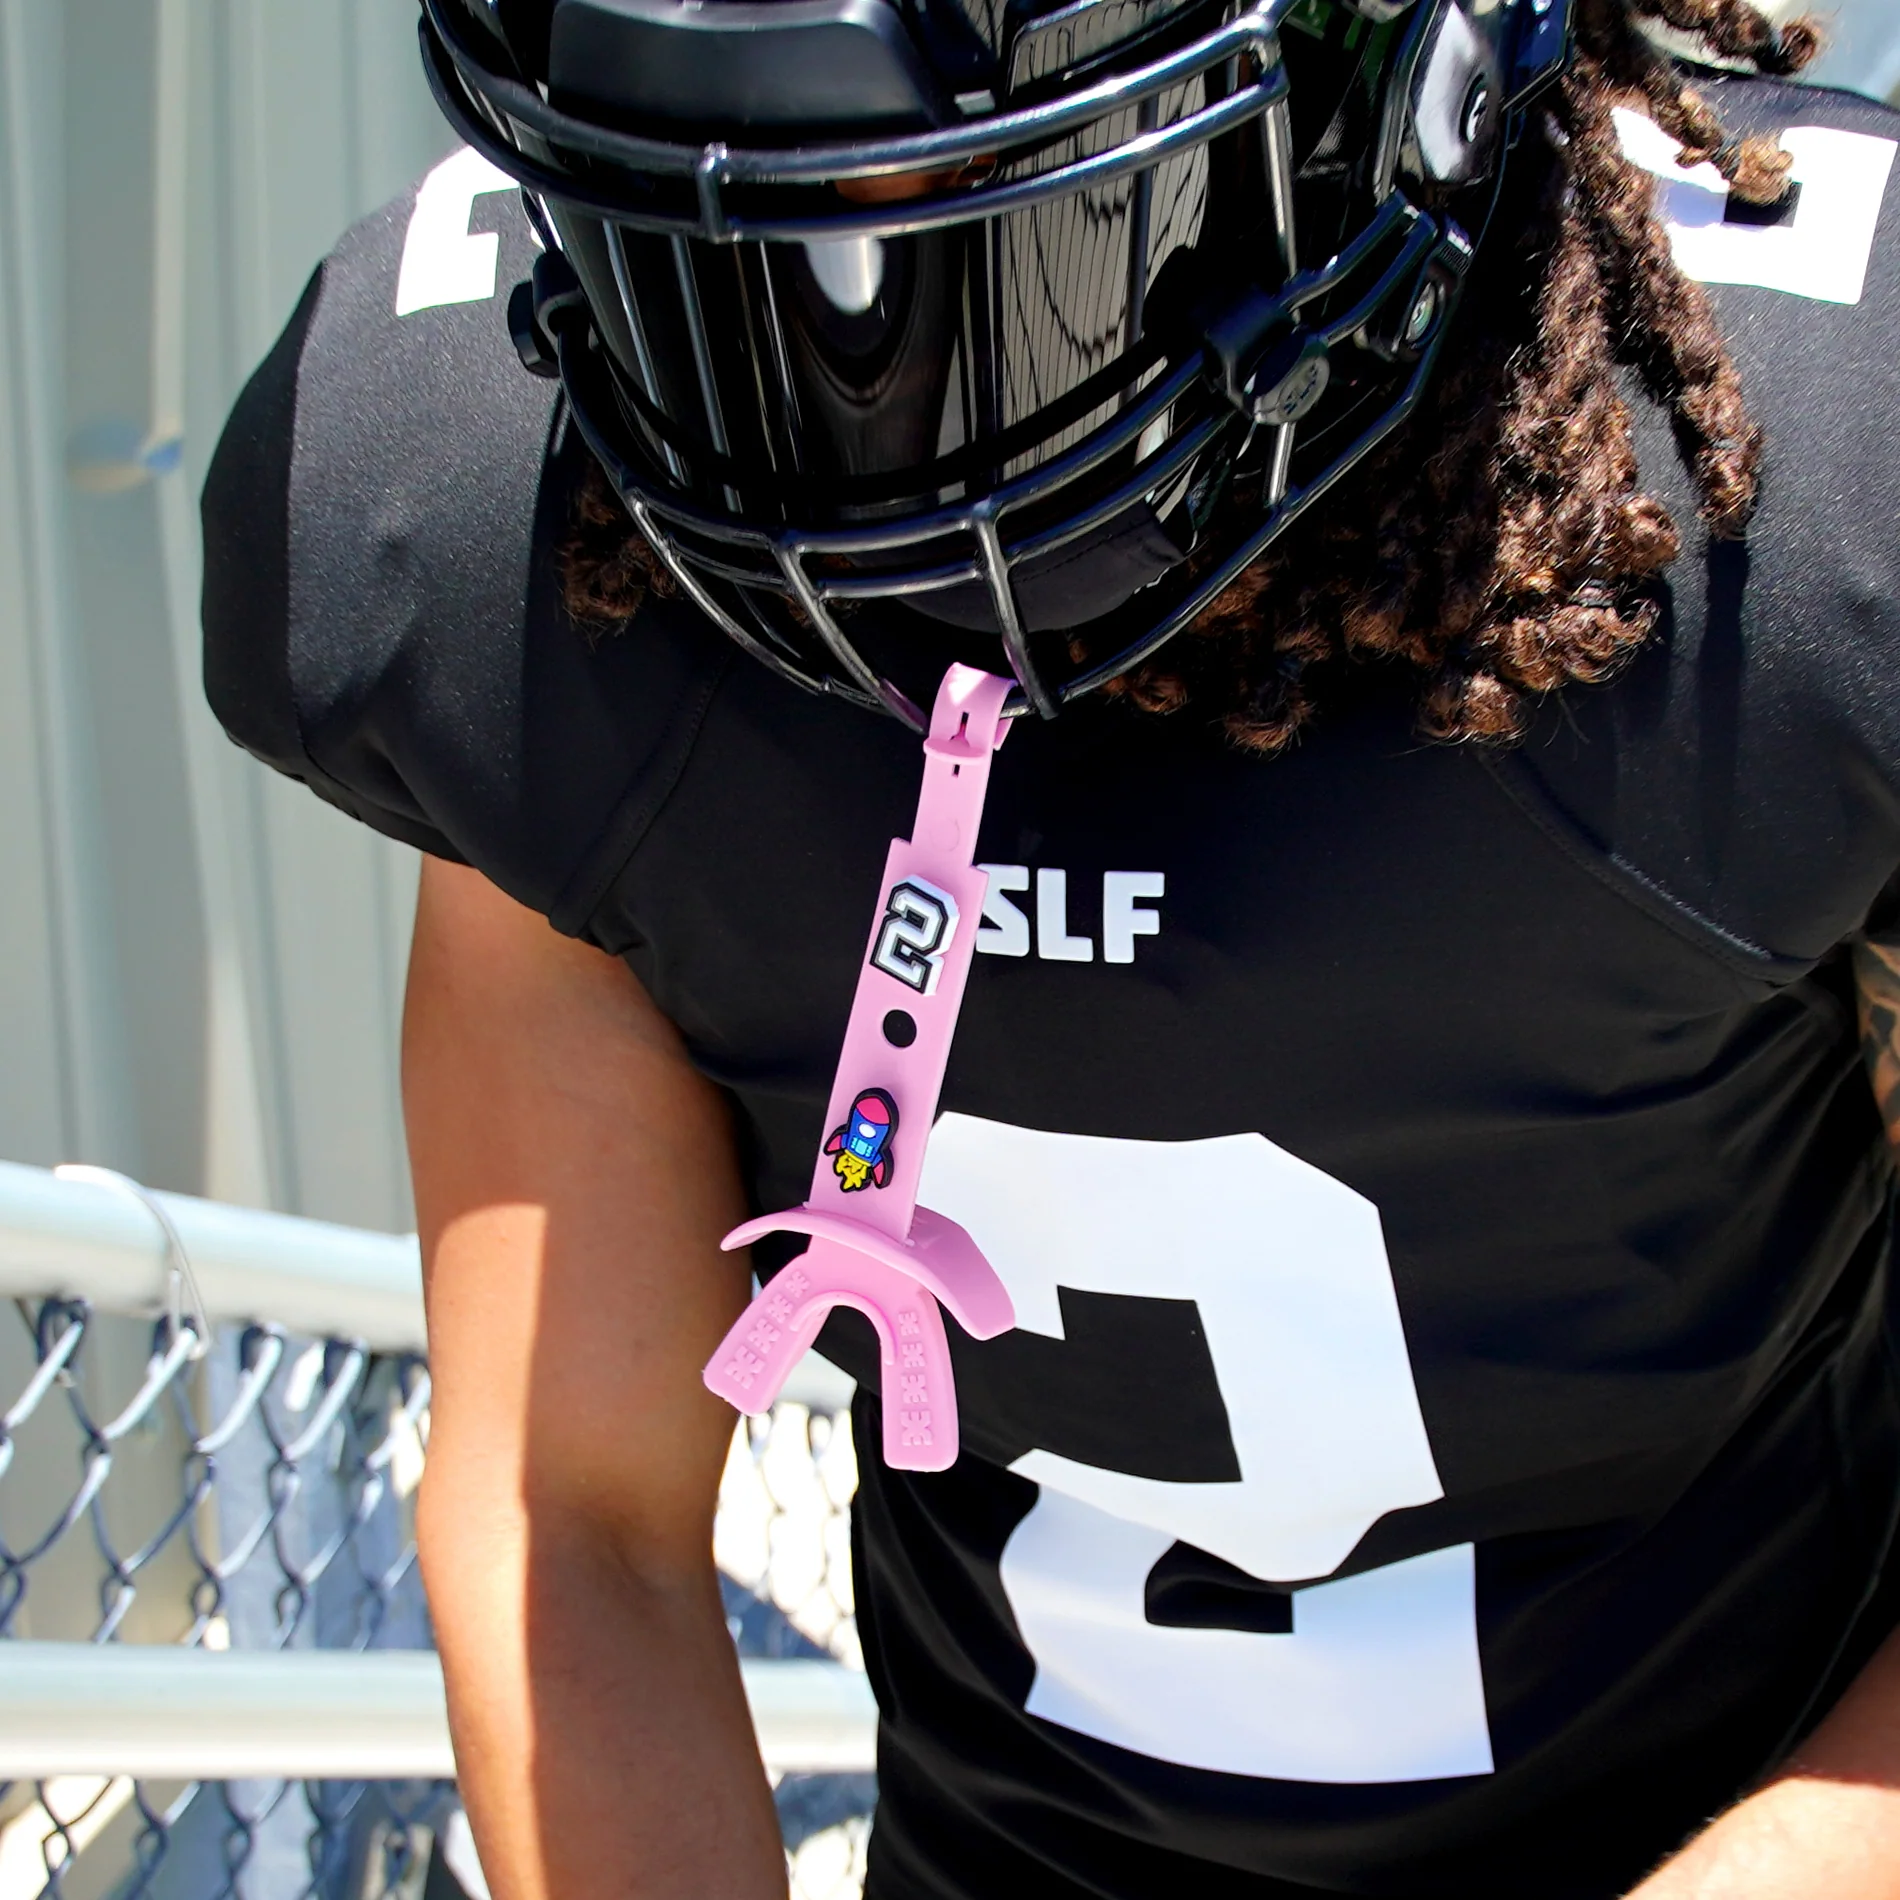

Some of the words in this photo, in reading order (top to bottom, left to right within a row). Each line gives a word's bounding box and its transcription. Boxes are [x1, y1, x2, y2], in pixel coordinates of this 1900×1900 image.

[869, 874, 960, 996] 2
[975, 863, 1165, 963] SLF
[918, 1111, 1494, 1783] 2
